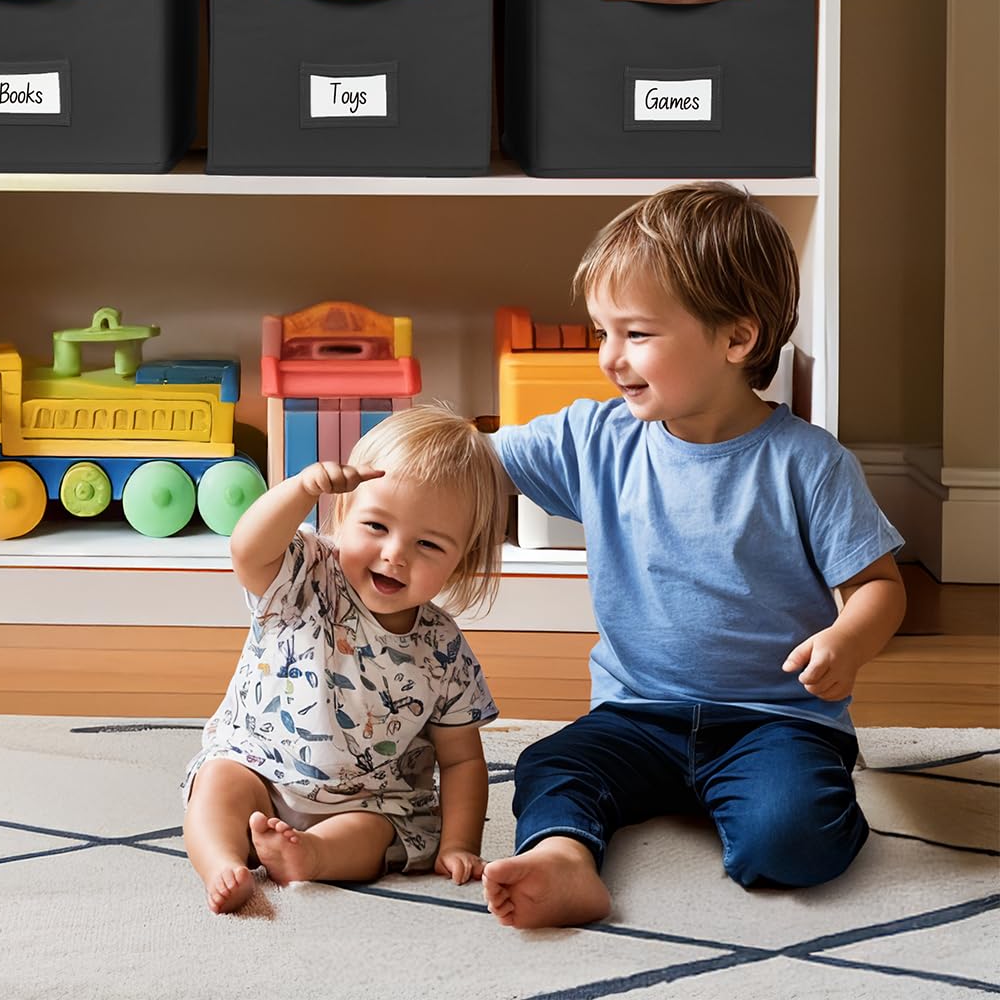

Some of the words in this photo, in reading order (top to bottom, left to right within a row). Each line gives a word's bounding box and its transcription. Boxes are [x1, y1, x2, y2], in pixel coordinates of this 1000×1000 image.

[0, 82, 43, 104] Books
[329, 82, 367, 113] Toys
[645, 87, 700, 110] Games
